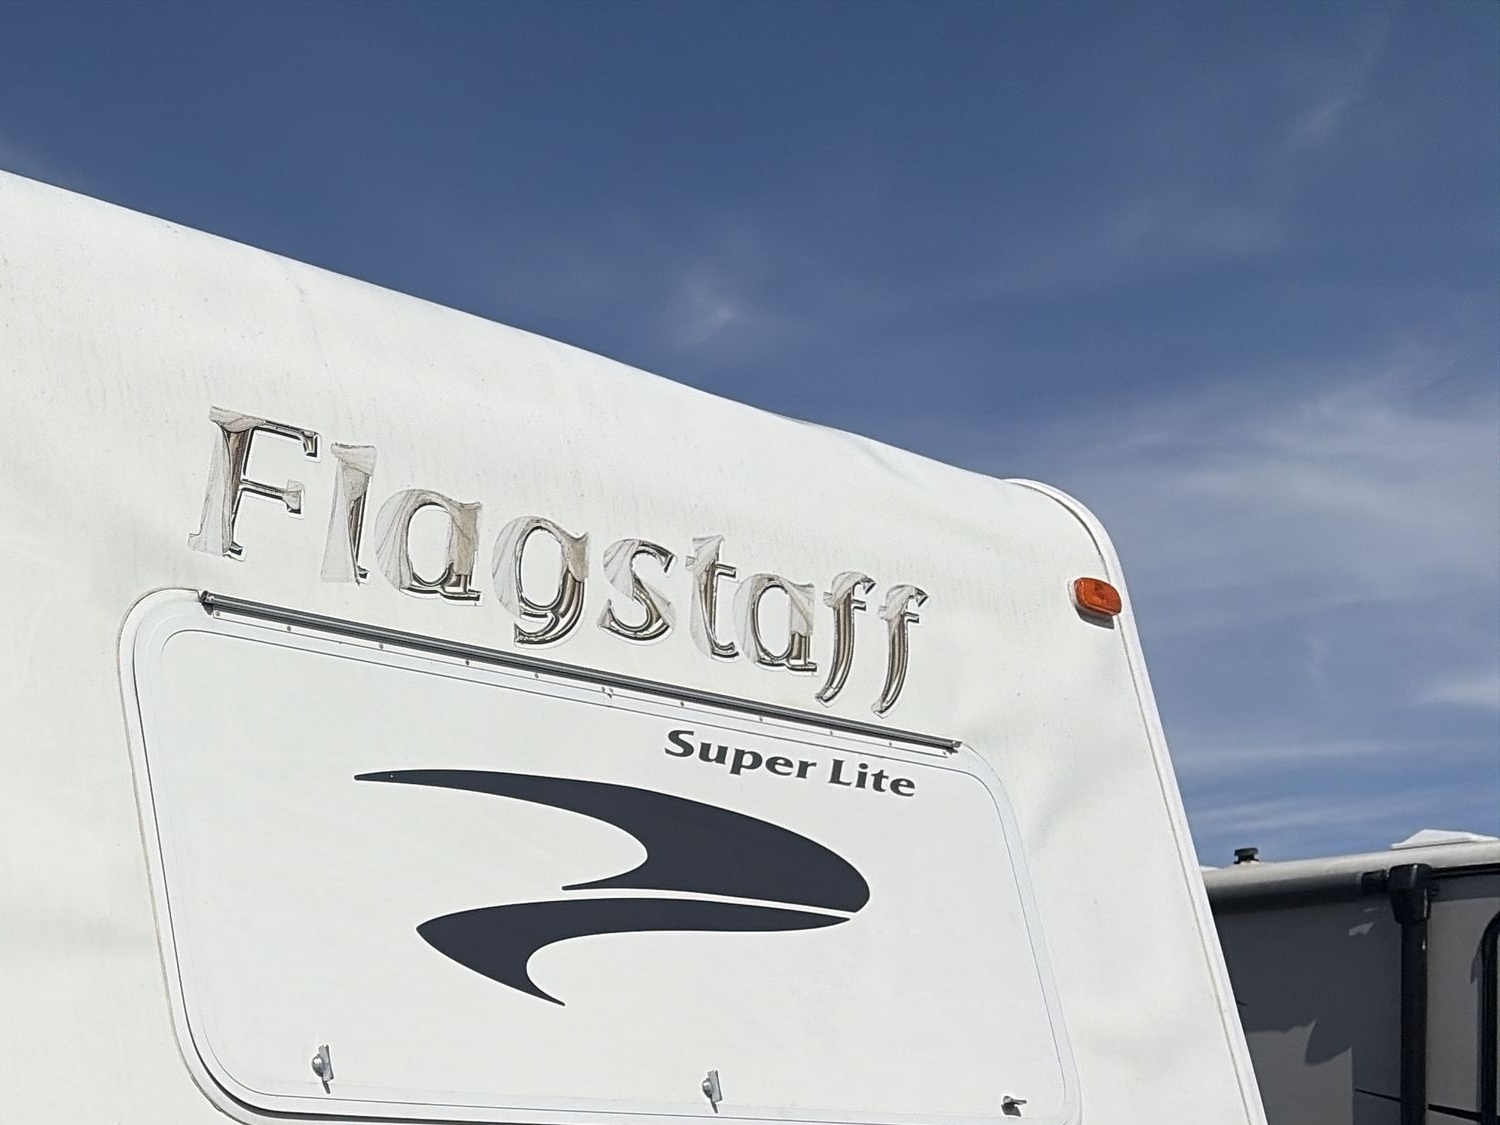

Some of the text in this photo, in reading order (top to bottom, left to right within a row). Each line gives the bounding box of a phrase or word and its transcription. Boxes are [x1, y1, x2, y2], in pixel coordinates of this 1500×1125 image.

[188, 406, 929, 717] Flagstaff
[664, 729, 916, 797] Super Lite
